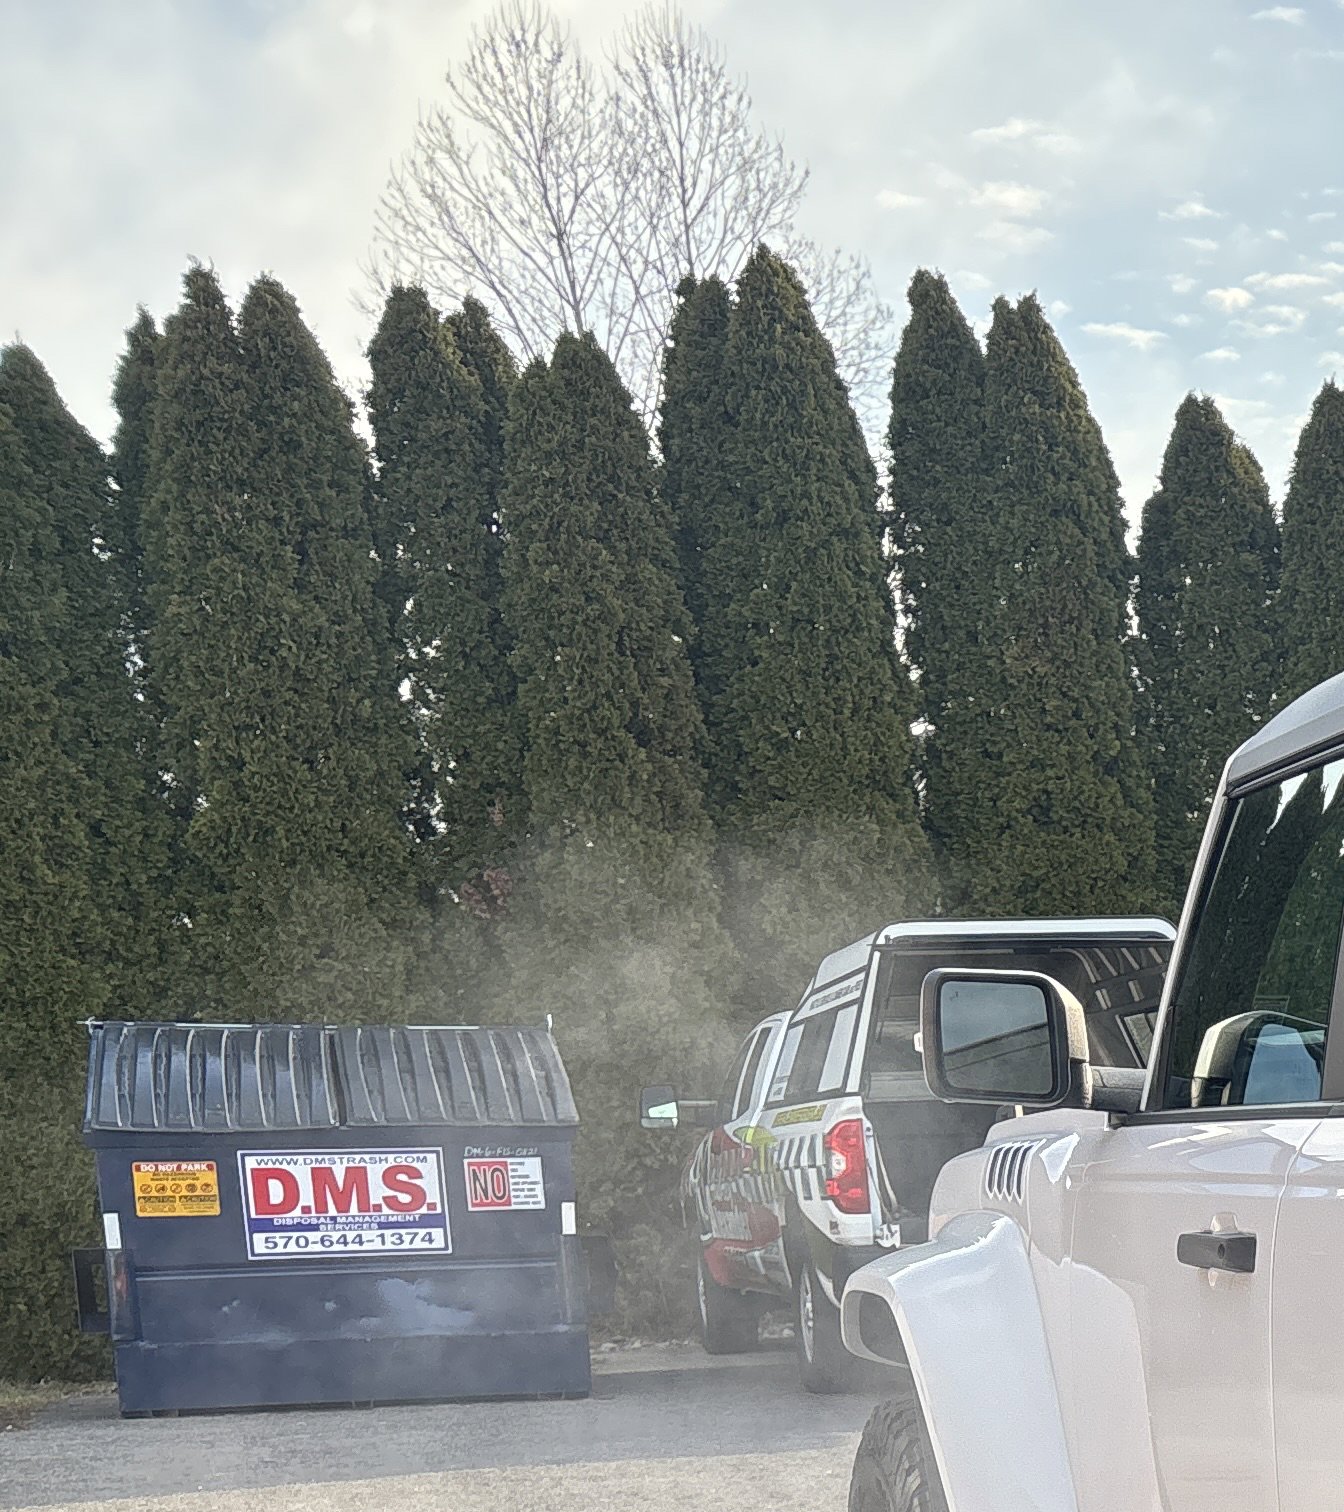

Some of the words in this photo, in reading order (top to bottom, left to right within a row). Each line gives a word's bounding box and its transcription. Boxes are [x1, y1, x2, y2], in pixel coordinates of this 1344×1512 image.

[255, 1155, 428, 1167] WWW.DMSTRASH.COM
[250, 1165, 437, 1216] D.M.S.
[470, 1165, 509, 1203] NO
[273, 1216, 334, 1226] DISPOSAL
[336, 1214, 421, 1223] MANAGEMENT
[319, 1222, 379, 1231] SERVICES
[263, 1231, 436, 1250] 570-644-1374
